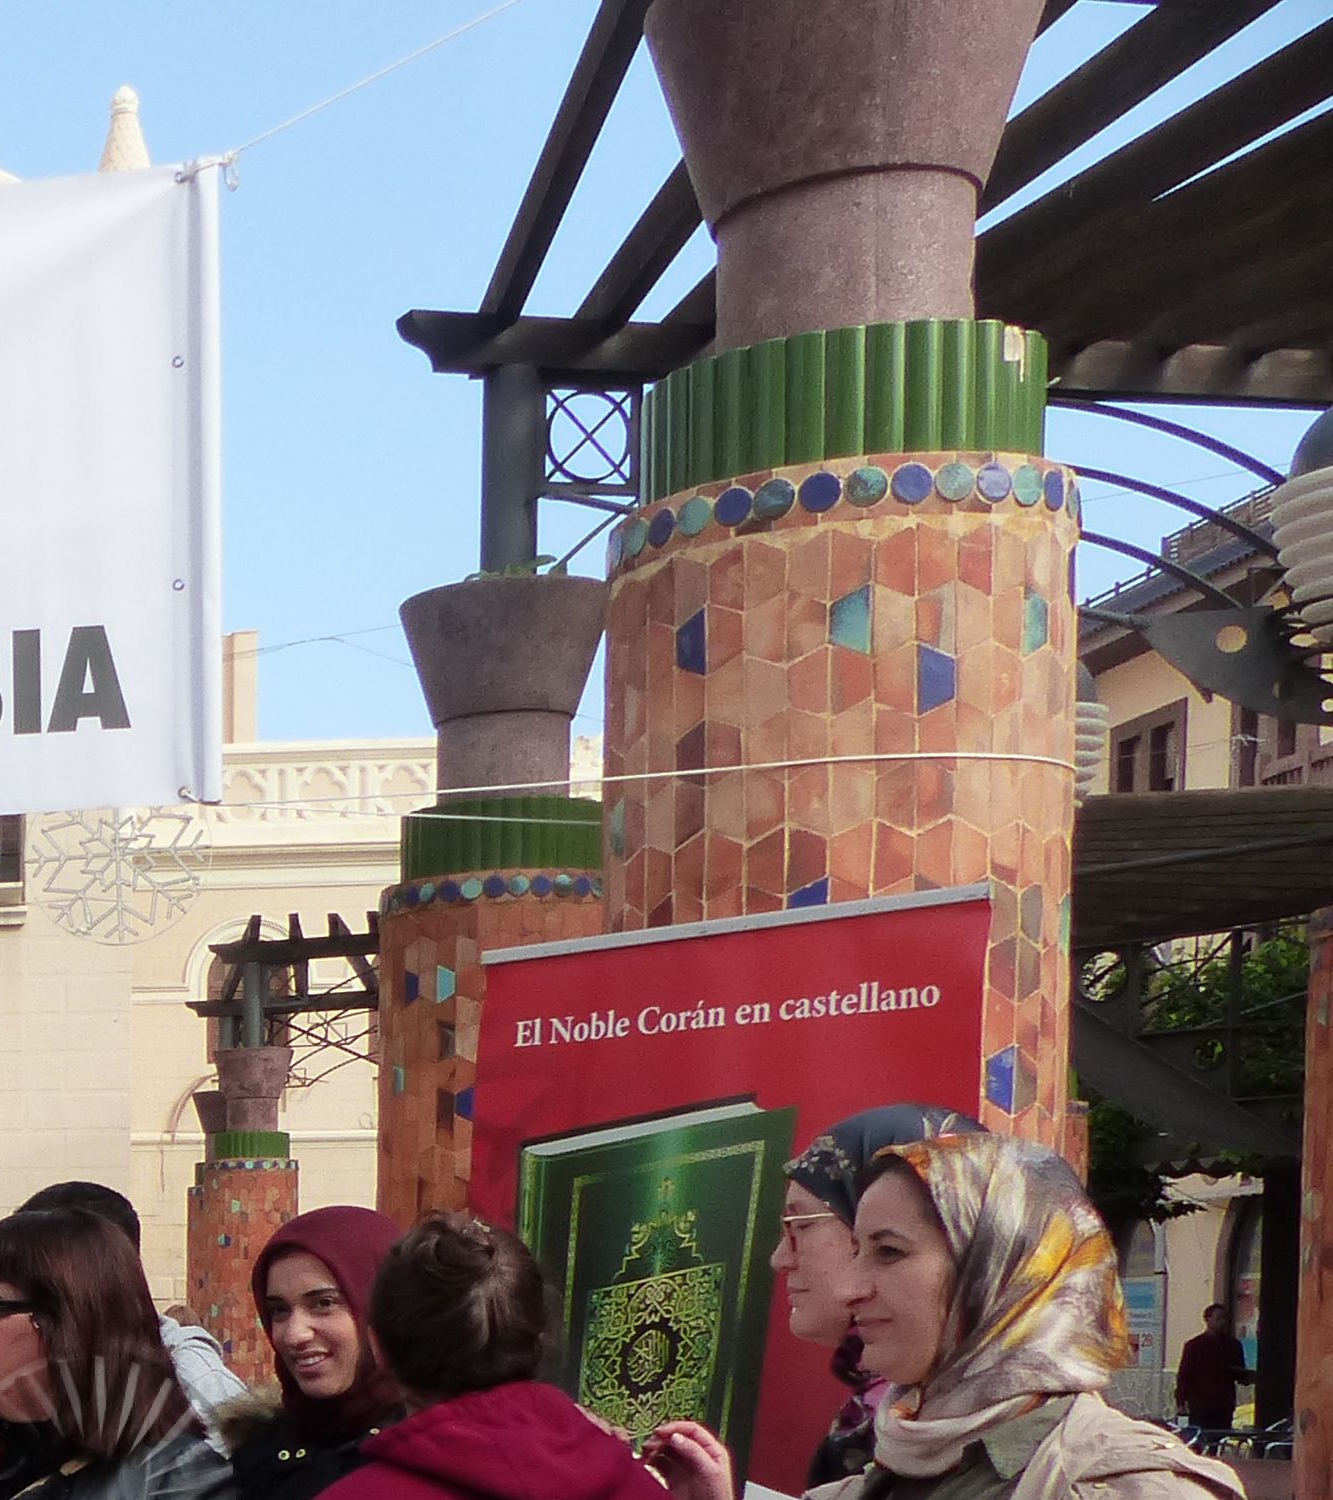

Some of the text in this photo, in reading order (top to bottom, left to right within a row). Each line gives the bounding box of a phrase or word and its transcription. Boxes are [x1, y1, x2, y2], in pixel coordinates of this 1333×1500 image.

[514, 981, 941, 1047] El Noble Corán en castellano
